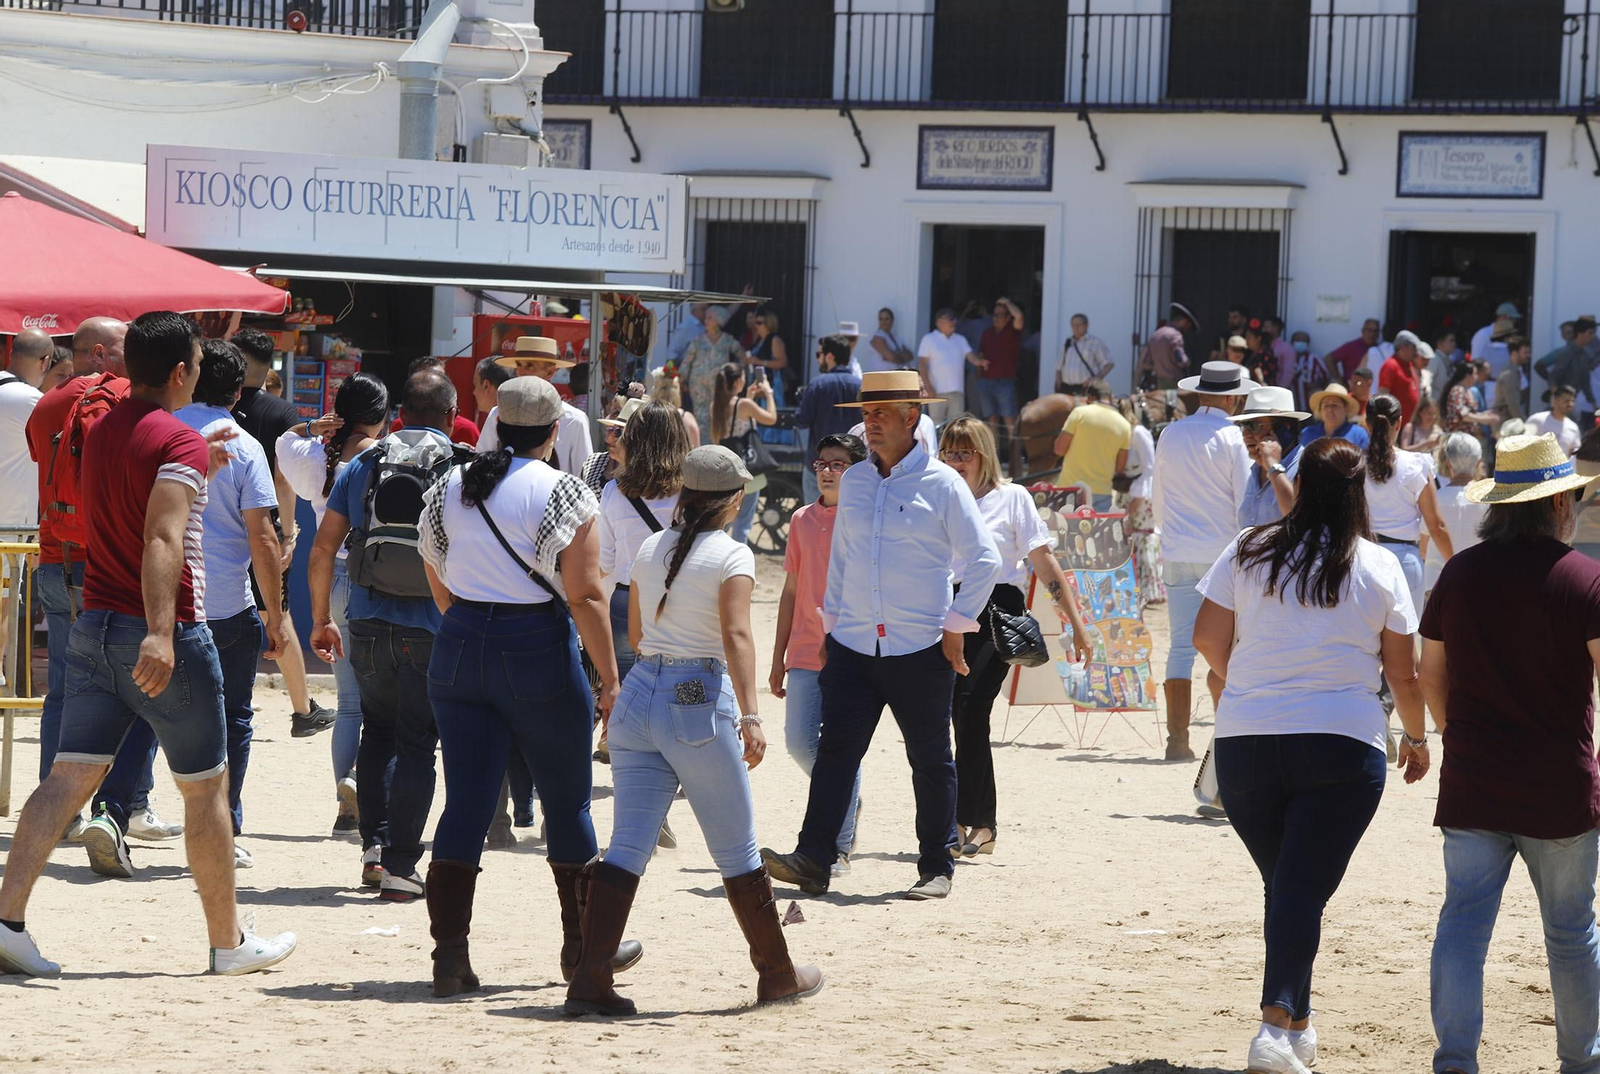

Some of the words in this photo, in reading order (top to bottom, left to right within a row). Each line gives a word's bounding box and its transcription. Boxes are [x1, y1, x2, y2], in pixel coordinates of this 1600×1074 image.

[1442, 147, 1485, 162] Tesoro
[175, 169, 293, 211] KIOSCO
[302, 177, 476, 222] CHURRERIA
[488, 184, 665, 232] "FLORENCIA"
[561, 236, 606, 252] Artesanos
[608, 238, 635, 254] desde
[637, 240, 661, 255] 1.940
